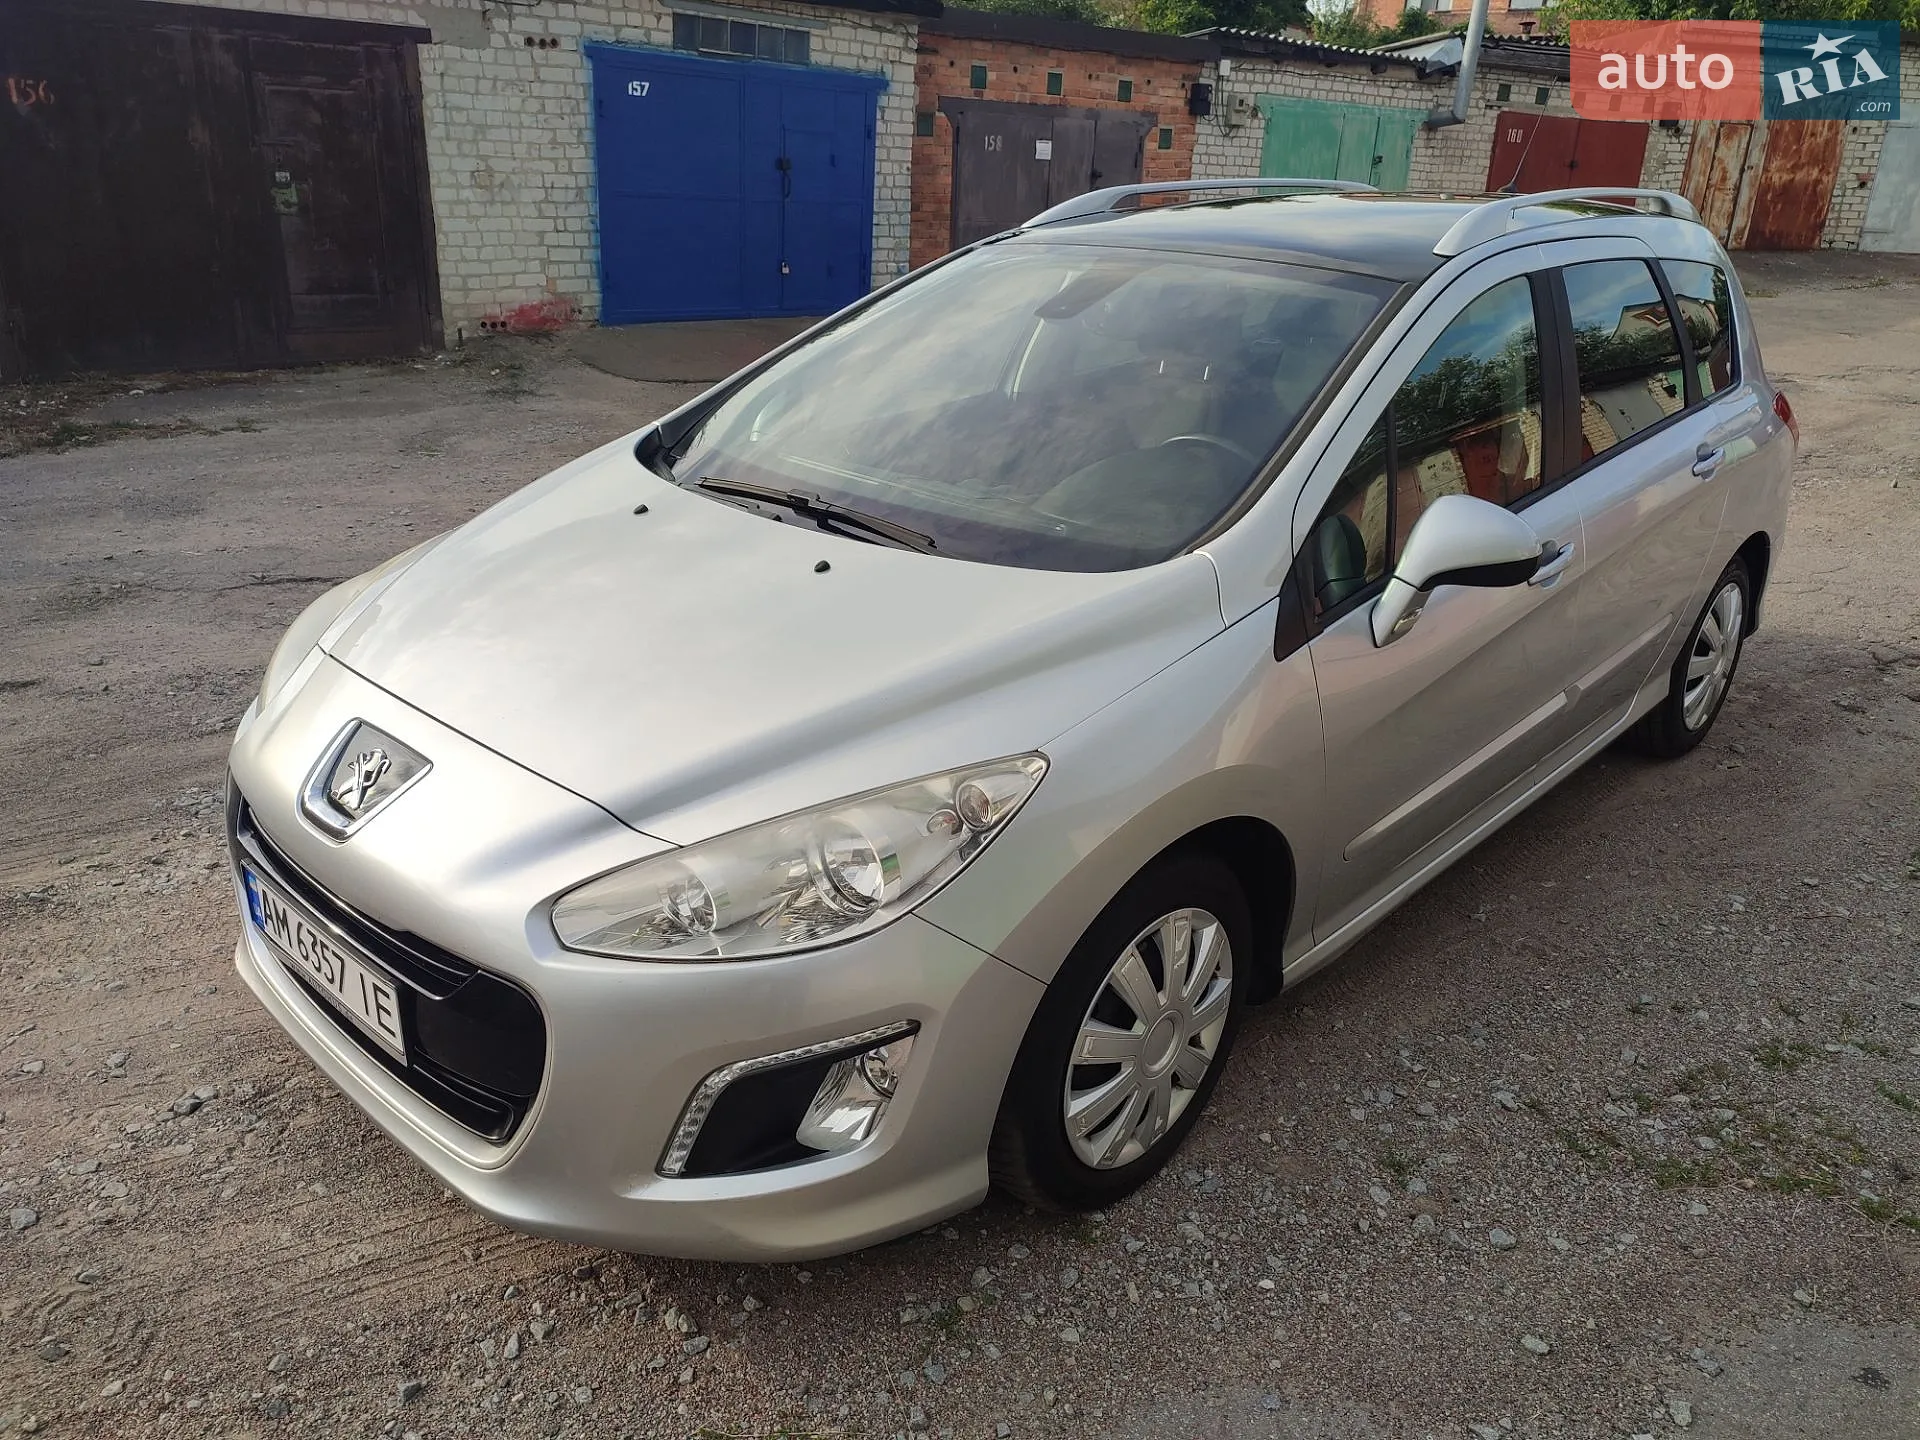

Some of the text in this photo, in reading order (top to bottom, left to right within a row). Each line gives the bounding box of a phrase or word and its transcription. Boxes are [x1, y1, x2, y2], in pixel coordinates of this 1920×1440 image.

[8, 77, 56, 106] 156
[628, 80, 650, 97] 157
[984, 135, 1003, 152] 158
[1507, 128, 1524, 143] 160
[261, 888, 293, 950] AM
[296, 921, 346, 994] 6357
[359, 971, 397, 1039] IE
